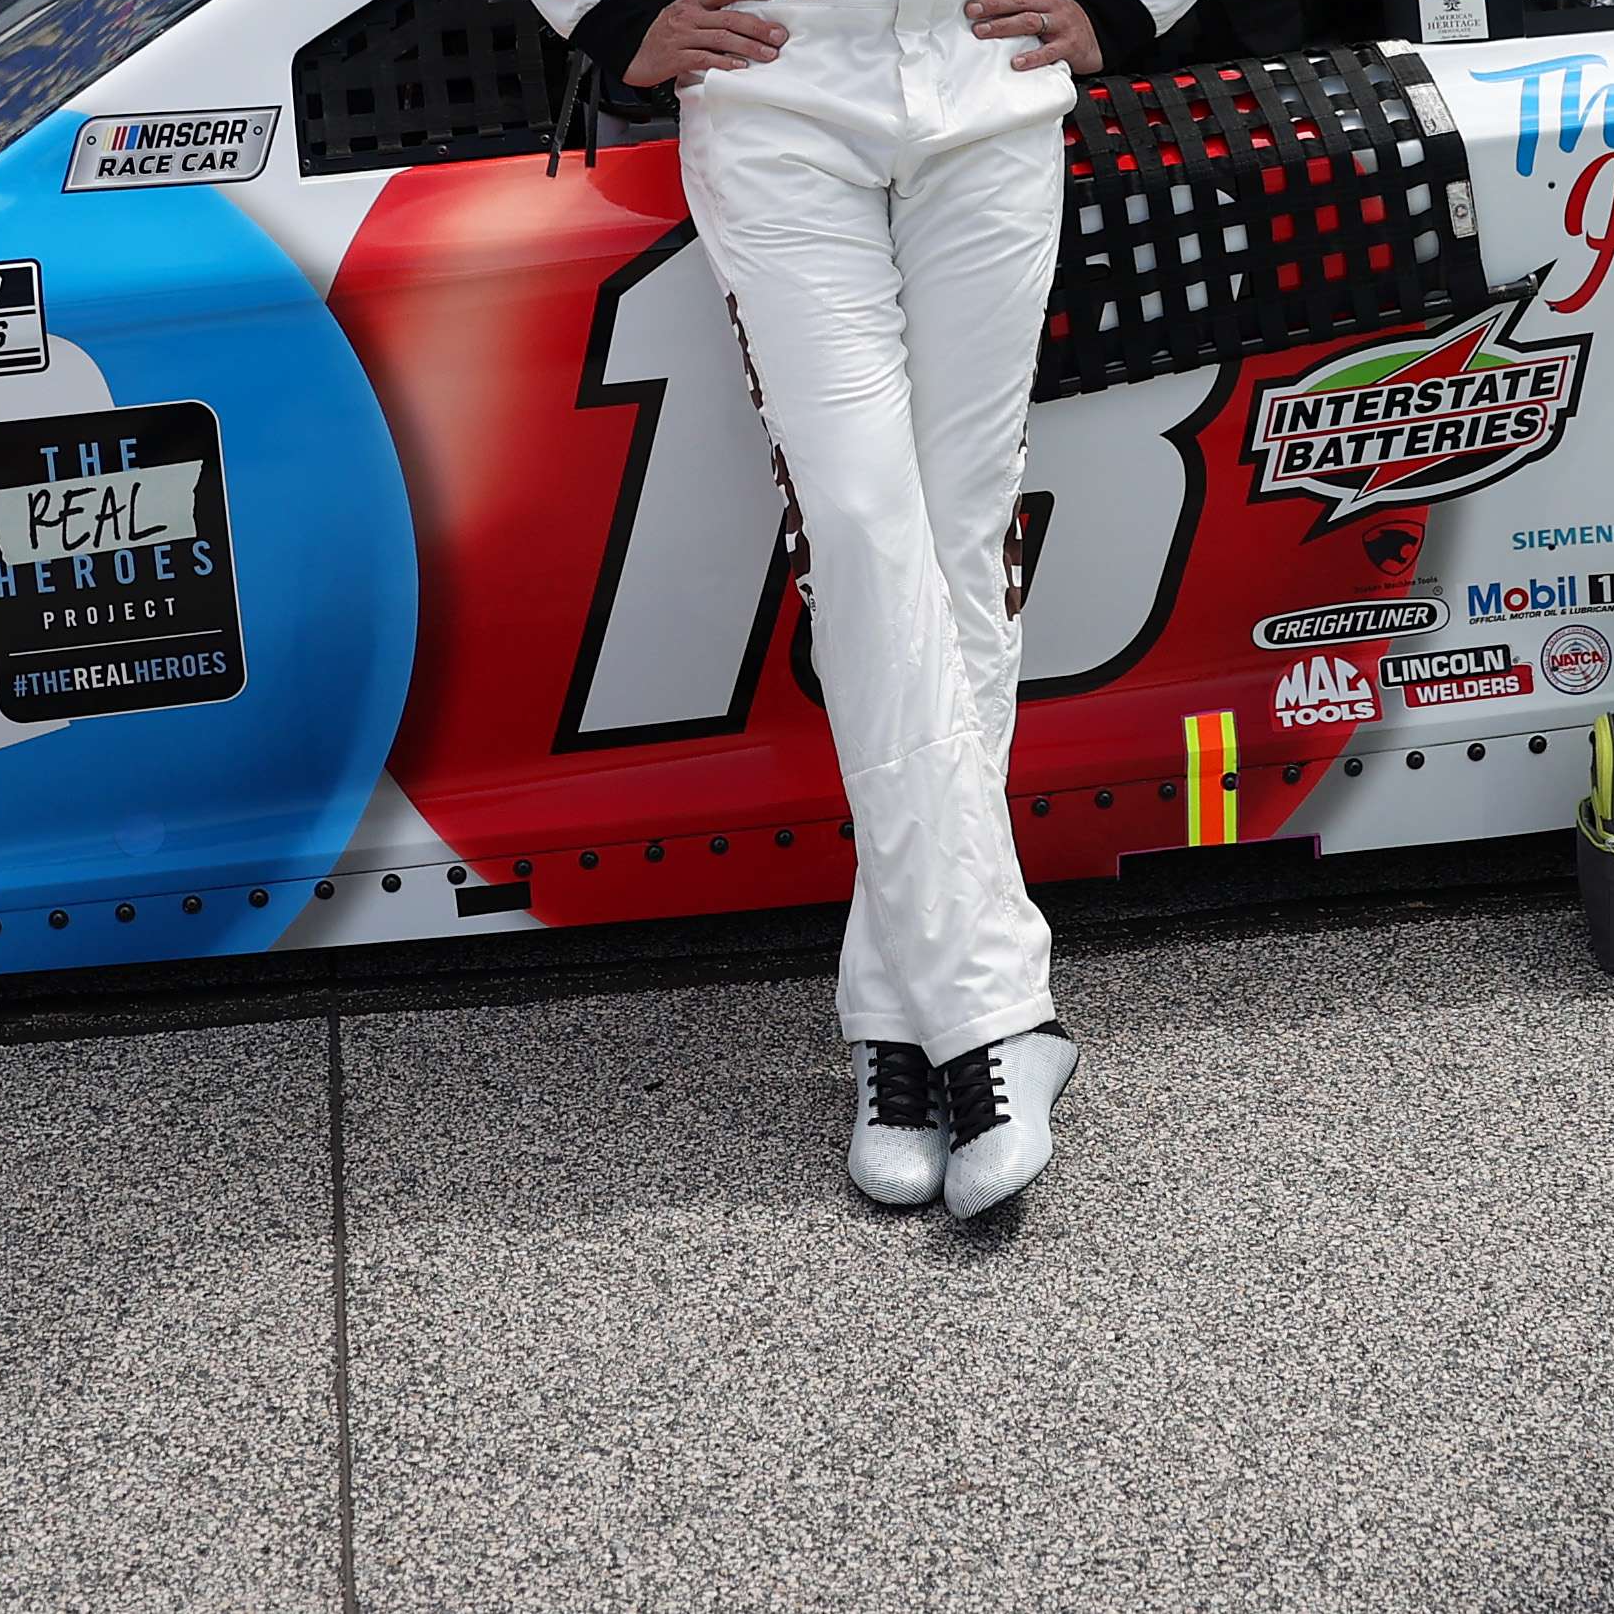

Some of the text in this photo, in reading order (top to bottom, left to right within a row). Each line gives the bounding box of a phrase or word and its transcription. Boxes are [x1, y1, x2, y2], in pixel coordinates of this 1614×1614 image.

[1427, 19, 1478, 30] HERITAGE
[1434, 13, 1473, 21] AMERICAN
[138, 119, 247, 150] NASCAR
[97, 150, 239, 180] RACE CAR
[1270, 362, 1562, 436] INTERSTATE
[1284, 406, 1542, 474] BATTERIES
[39, 436, 141, 484] THE
[27, 481, 168, 551] REAL
[1467, 575, 1613, 617] Mobil 1
[42, 597, 178, 630] PROJECT
[1272, 605, 1431, 642] FREIGHTLINER
[1469, 613, 1507, 625] OFFICIAL
[1509, 610, 1542, 621] MOTOR
[1544, 607, 1559, 617] OIL
[13, 650, 227, 700] #THEREALHEROES
[1386, 648, 1505, 683] LINCOLN
[1550, 650, 1605, 667] NATCA
[1275, 655, 1375, 710] MAC
[1415, 676, 1520, 704] WELDERS
[1275, 700, 1377, 727] TOOLS
